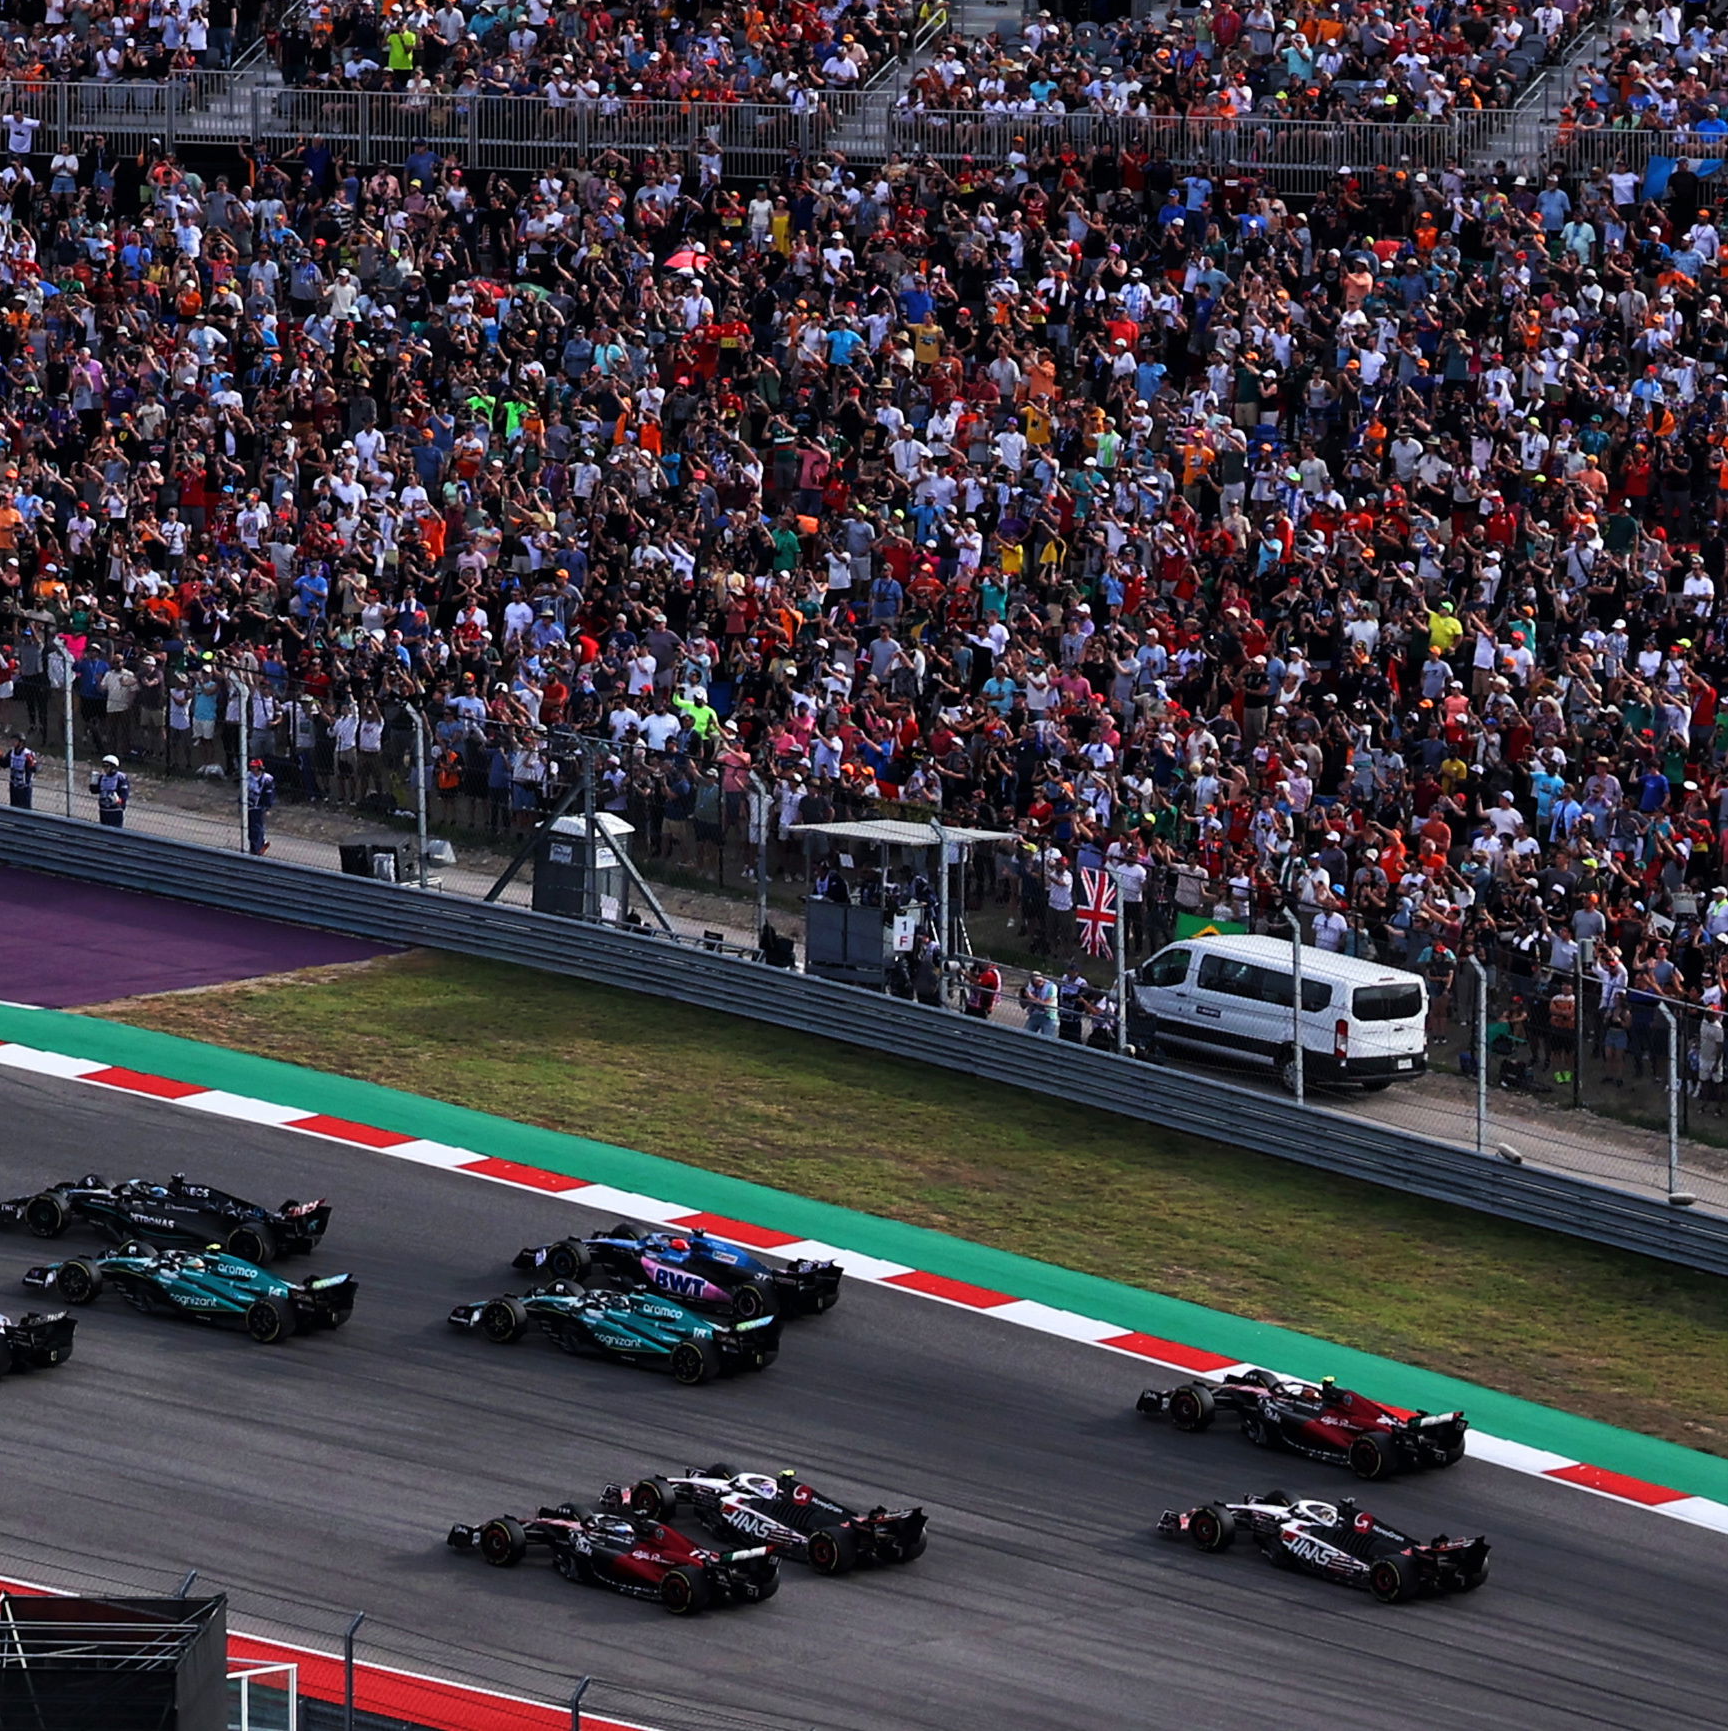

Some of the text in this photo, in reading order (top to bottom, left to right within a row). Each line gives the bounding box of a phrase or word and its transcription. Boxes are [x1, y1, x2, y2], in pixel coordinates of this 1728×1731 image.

[901, 921, 908, 932] 1
[899, 935, 908, 947] F
[217, 1263, 258, 1279] aramco
[655, 1266, 706, 1294] BWT
[170, 1292, 218, 1308] cognizant
[643, 1303, 683, 1319] aramco
[594, 1332, 642, 1349] cognizant
